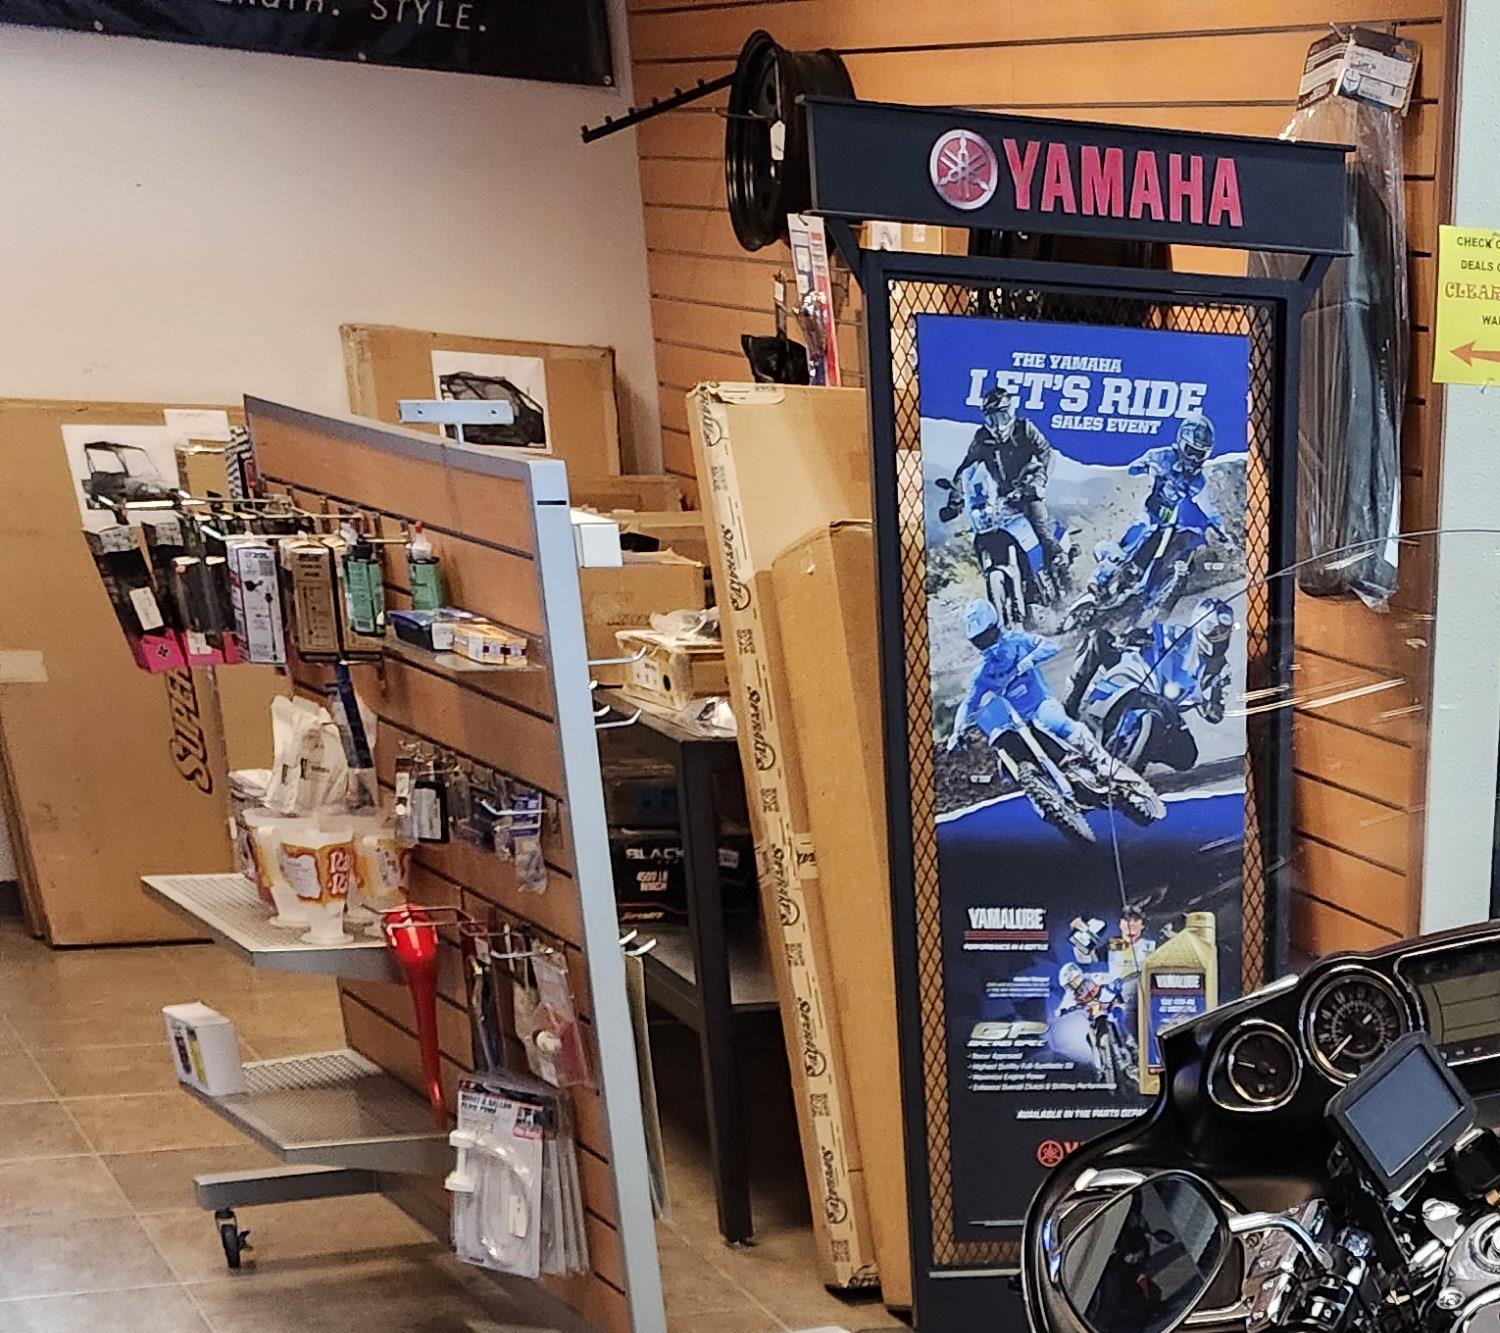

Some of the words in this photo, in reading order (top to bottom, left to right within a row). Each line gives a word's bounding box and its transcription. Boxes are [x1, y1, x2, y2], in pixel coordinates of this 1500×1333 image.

[370, 0, 487, 32] STYLE.
[1002, 136, 1244, 228] YAMAHA
[1456, 236, 1493, 249] CHECK
[1460, 259, 1494, 272] DEALS
[1011, 352, 1046, 369] THE
[1049, 354, 1123, 374] YAMAHA
[1097, 377, 1208, 420] RIDE
[1050, 414, 1104, 433] SALES
[1105, 417, 1165, 435] EVENT
[967, 907, 1046, 931] YAMALUBE
[969, 1021, 1050, 1040] GP
[1074, 1109, 1091, 1119] THE
[1091, 1109, 1121, 1118] PARTS
